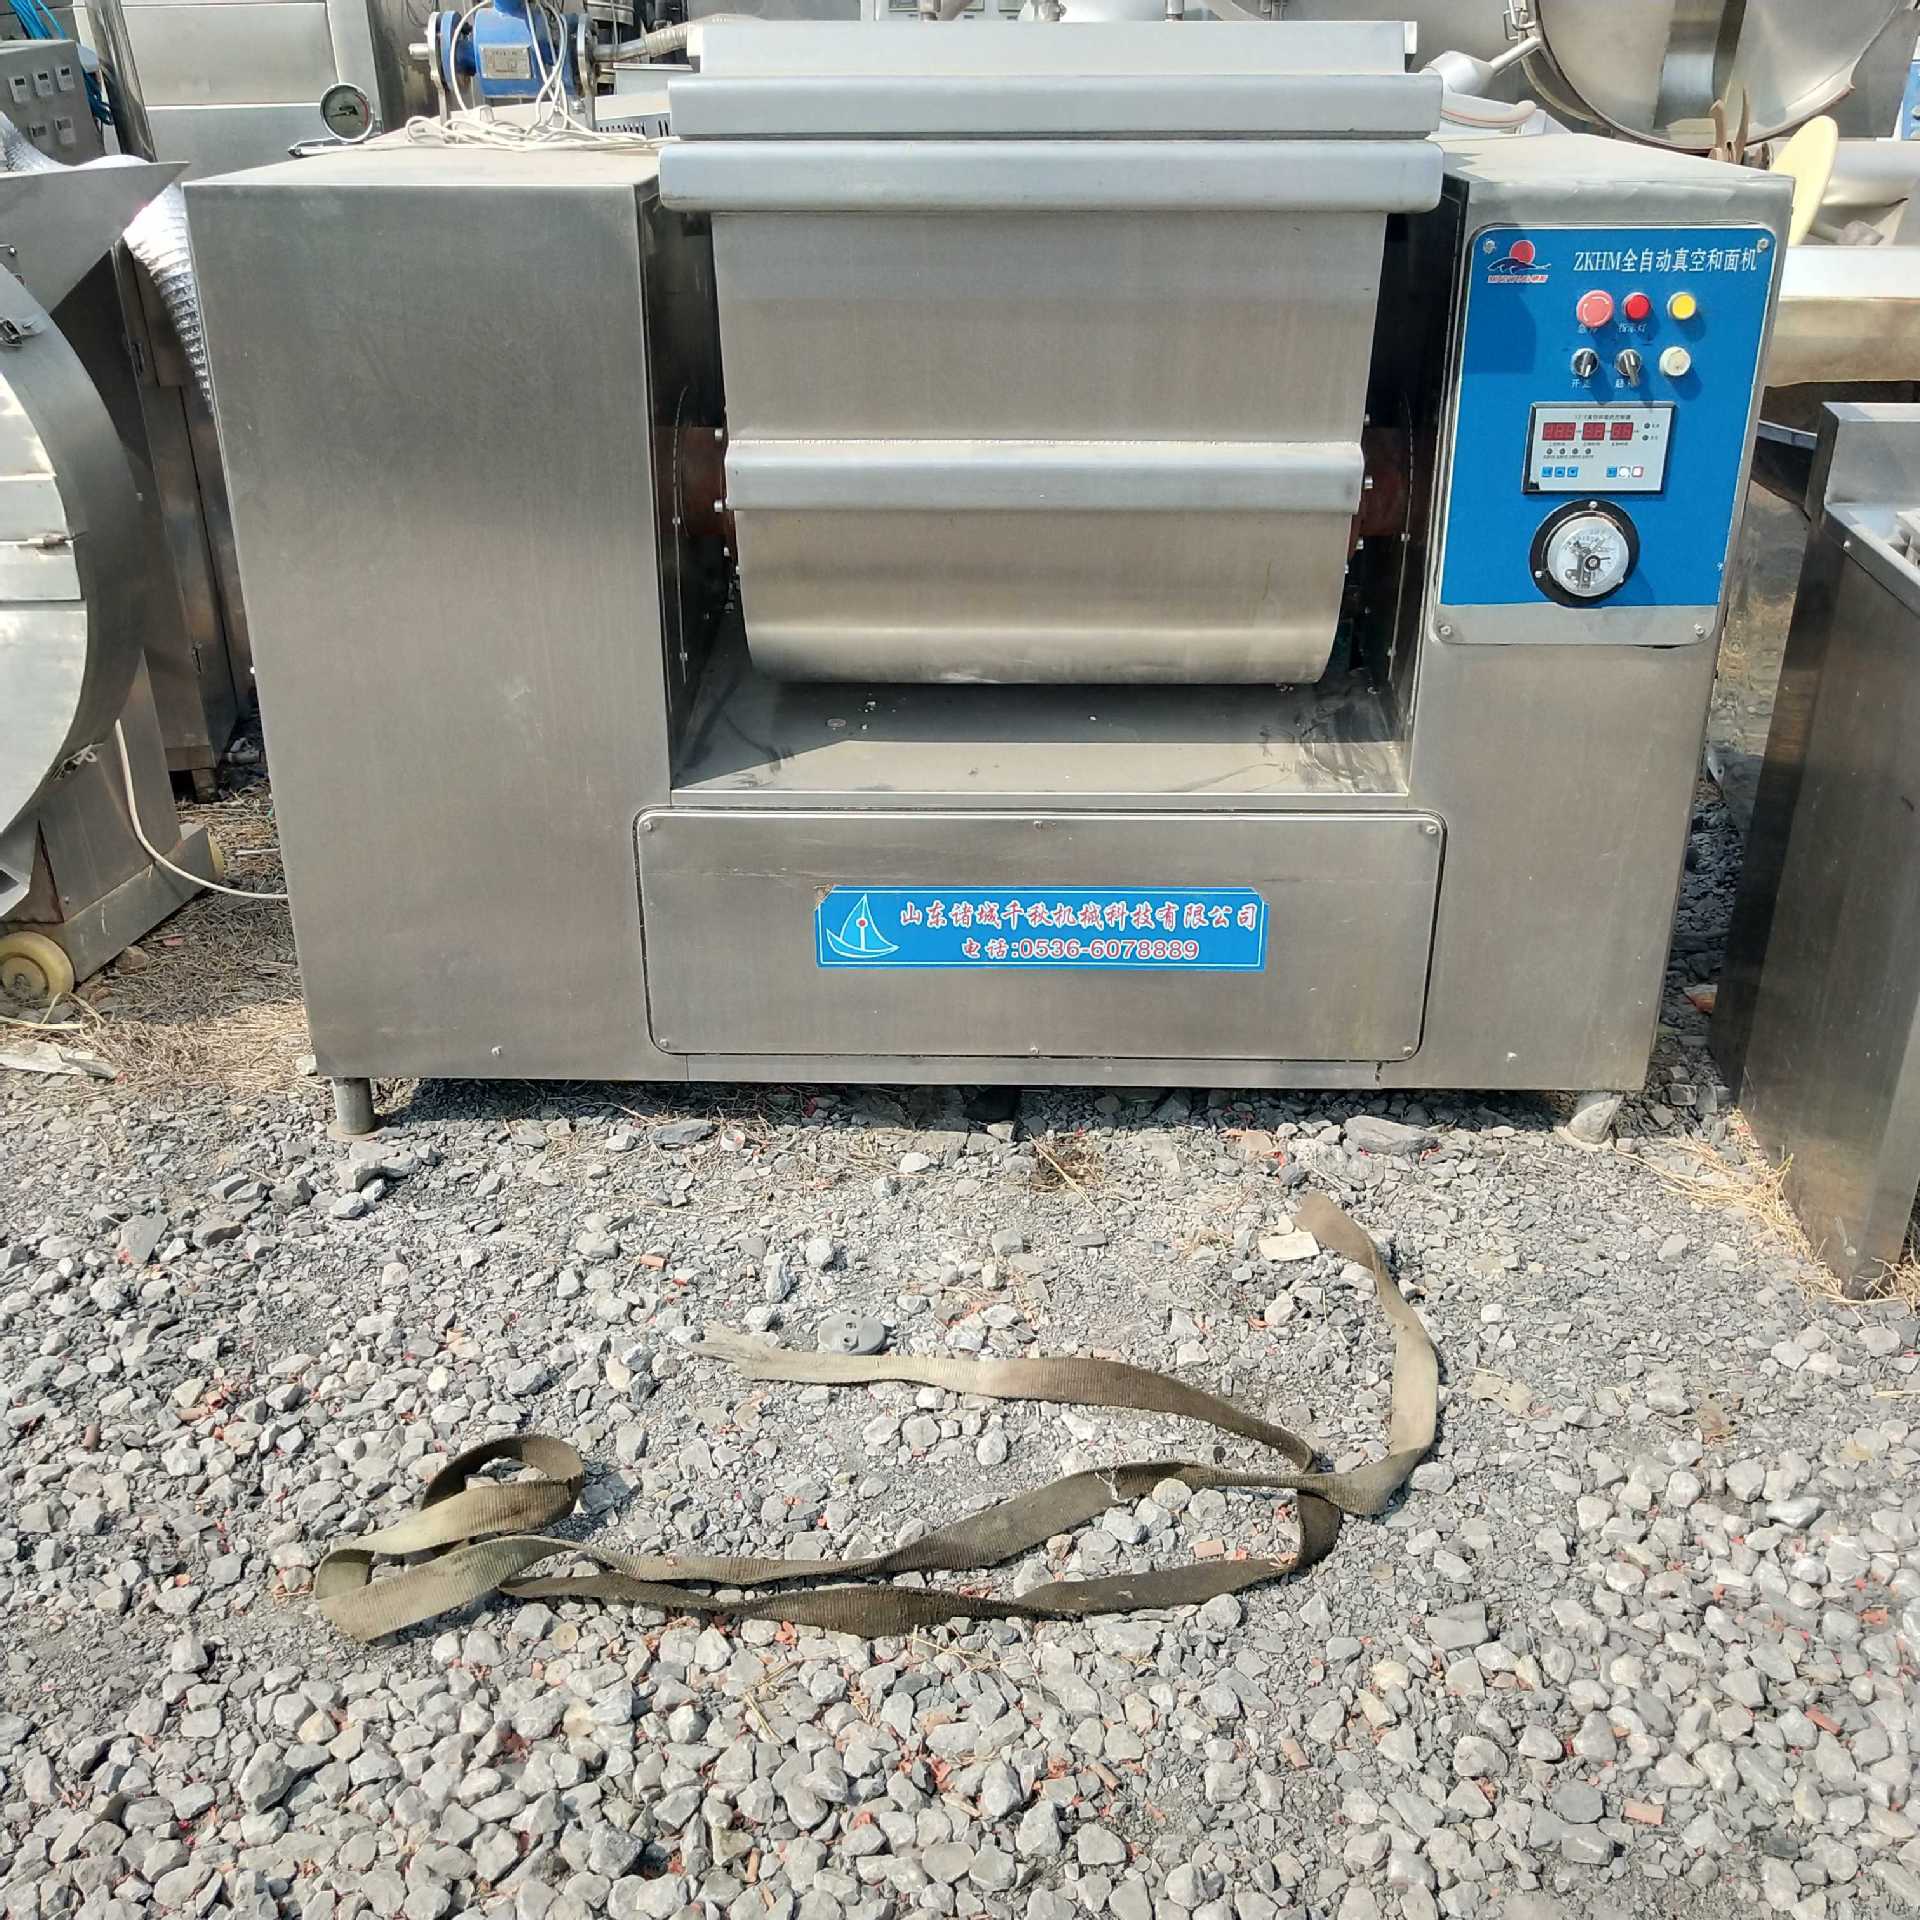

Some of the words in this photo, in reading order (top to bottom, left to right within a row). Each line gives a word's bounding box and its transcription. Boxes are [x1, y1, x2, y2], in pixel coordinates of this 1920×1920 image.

[1573, 248, 1757, 273] ZKHM全自动真空和面机
[900, 900, 1257, 931] 山东诸城千秋机械科技有限公司
[962, 937, 1199, 960] 电话:0536-6078889
